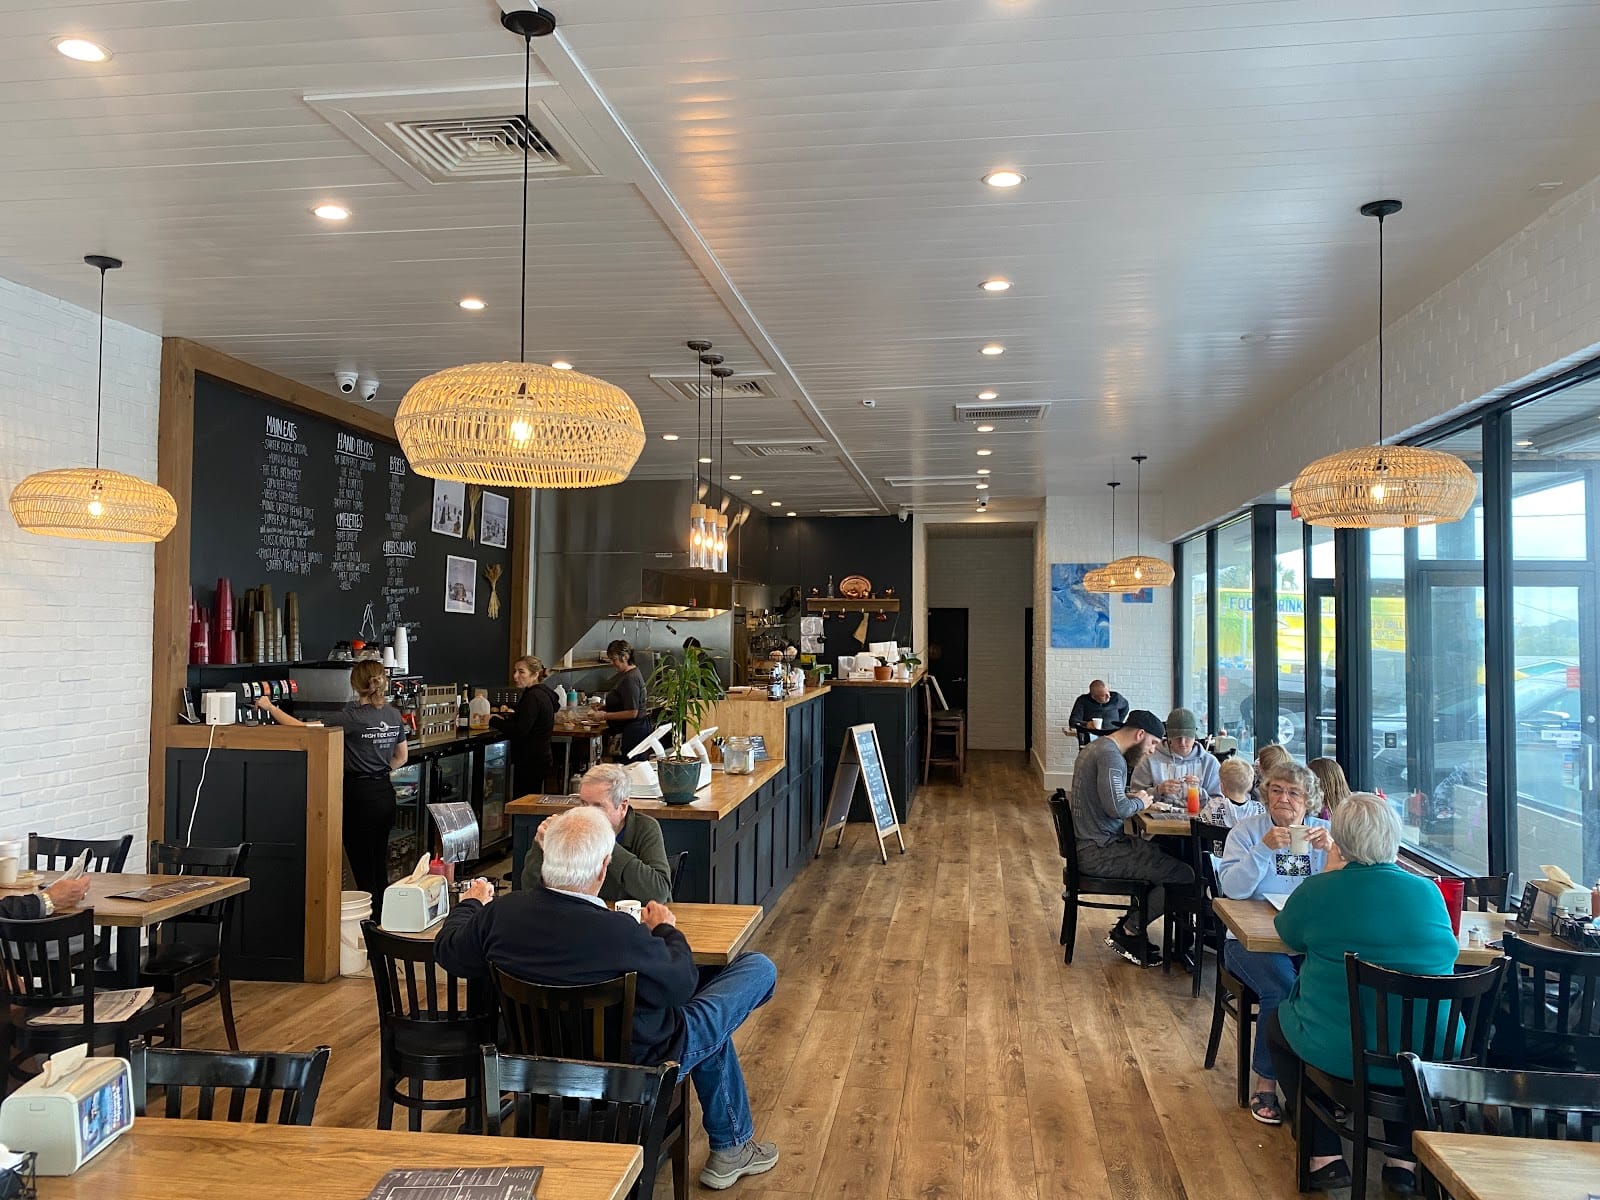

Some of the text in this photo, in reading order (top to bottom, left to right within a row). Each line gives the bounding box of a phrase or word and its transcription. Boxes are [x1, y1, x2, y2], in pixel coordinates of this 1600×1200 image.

[266, 415, 298, 441] MAIN EATS
[337, 432, 374, 457] HAND HELDS
[336, 512, 364, 529] OMELETTES
[1229, 597, 1304, 613] FOO RINK
